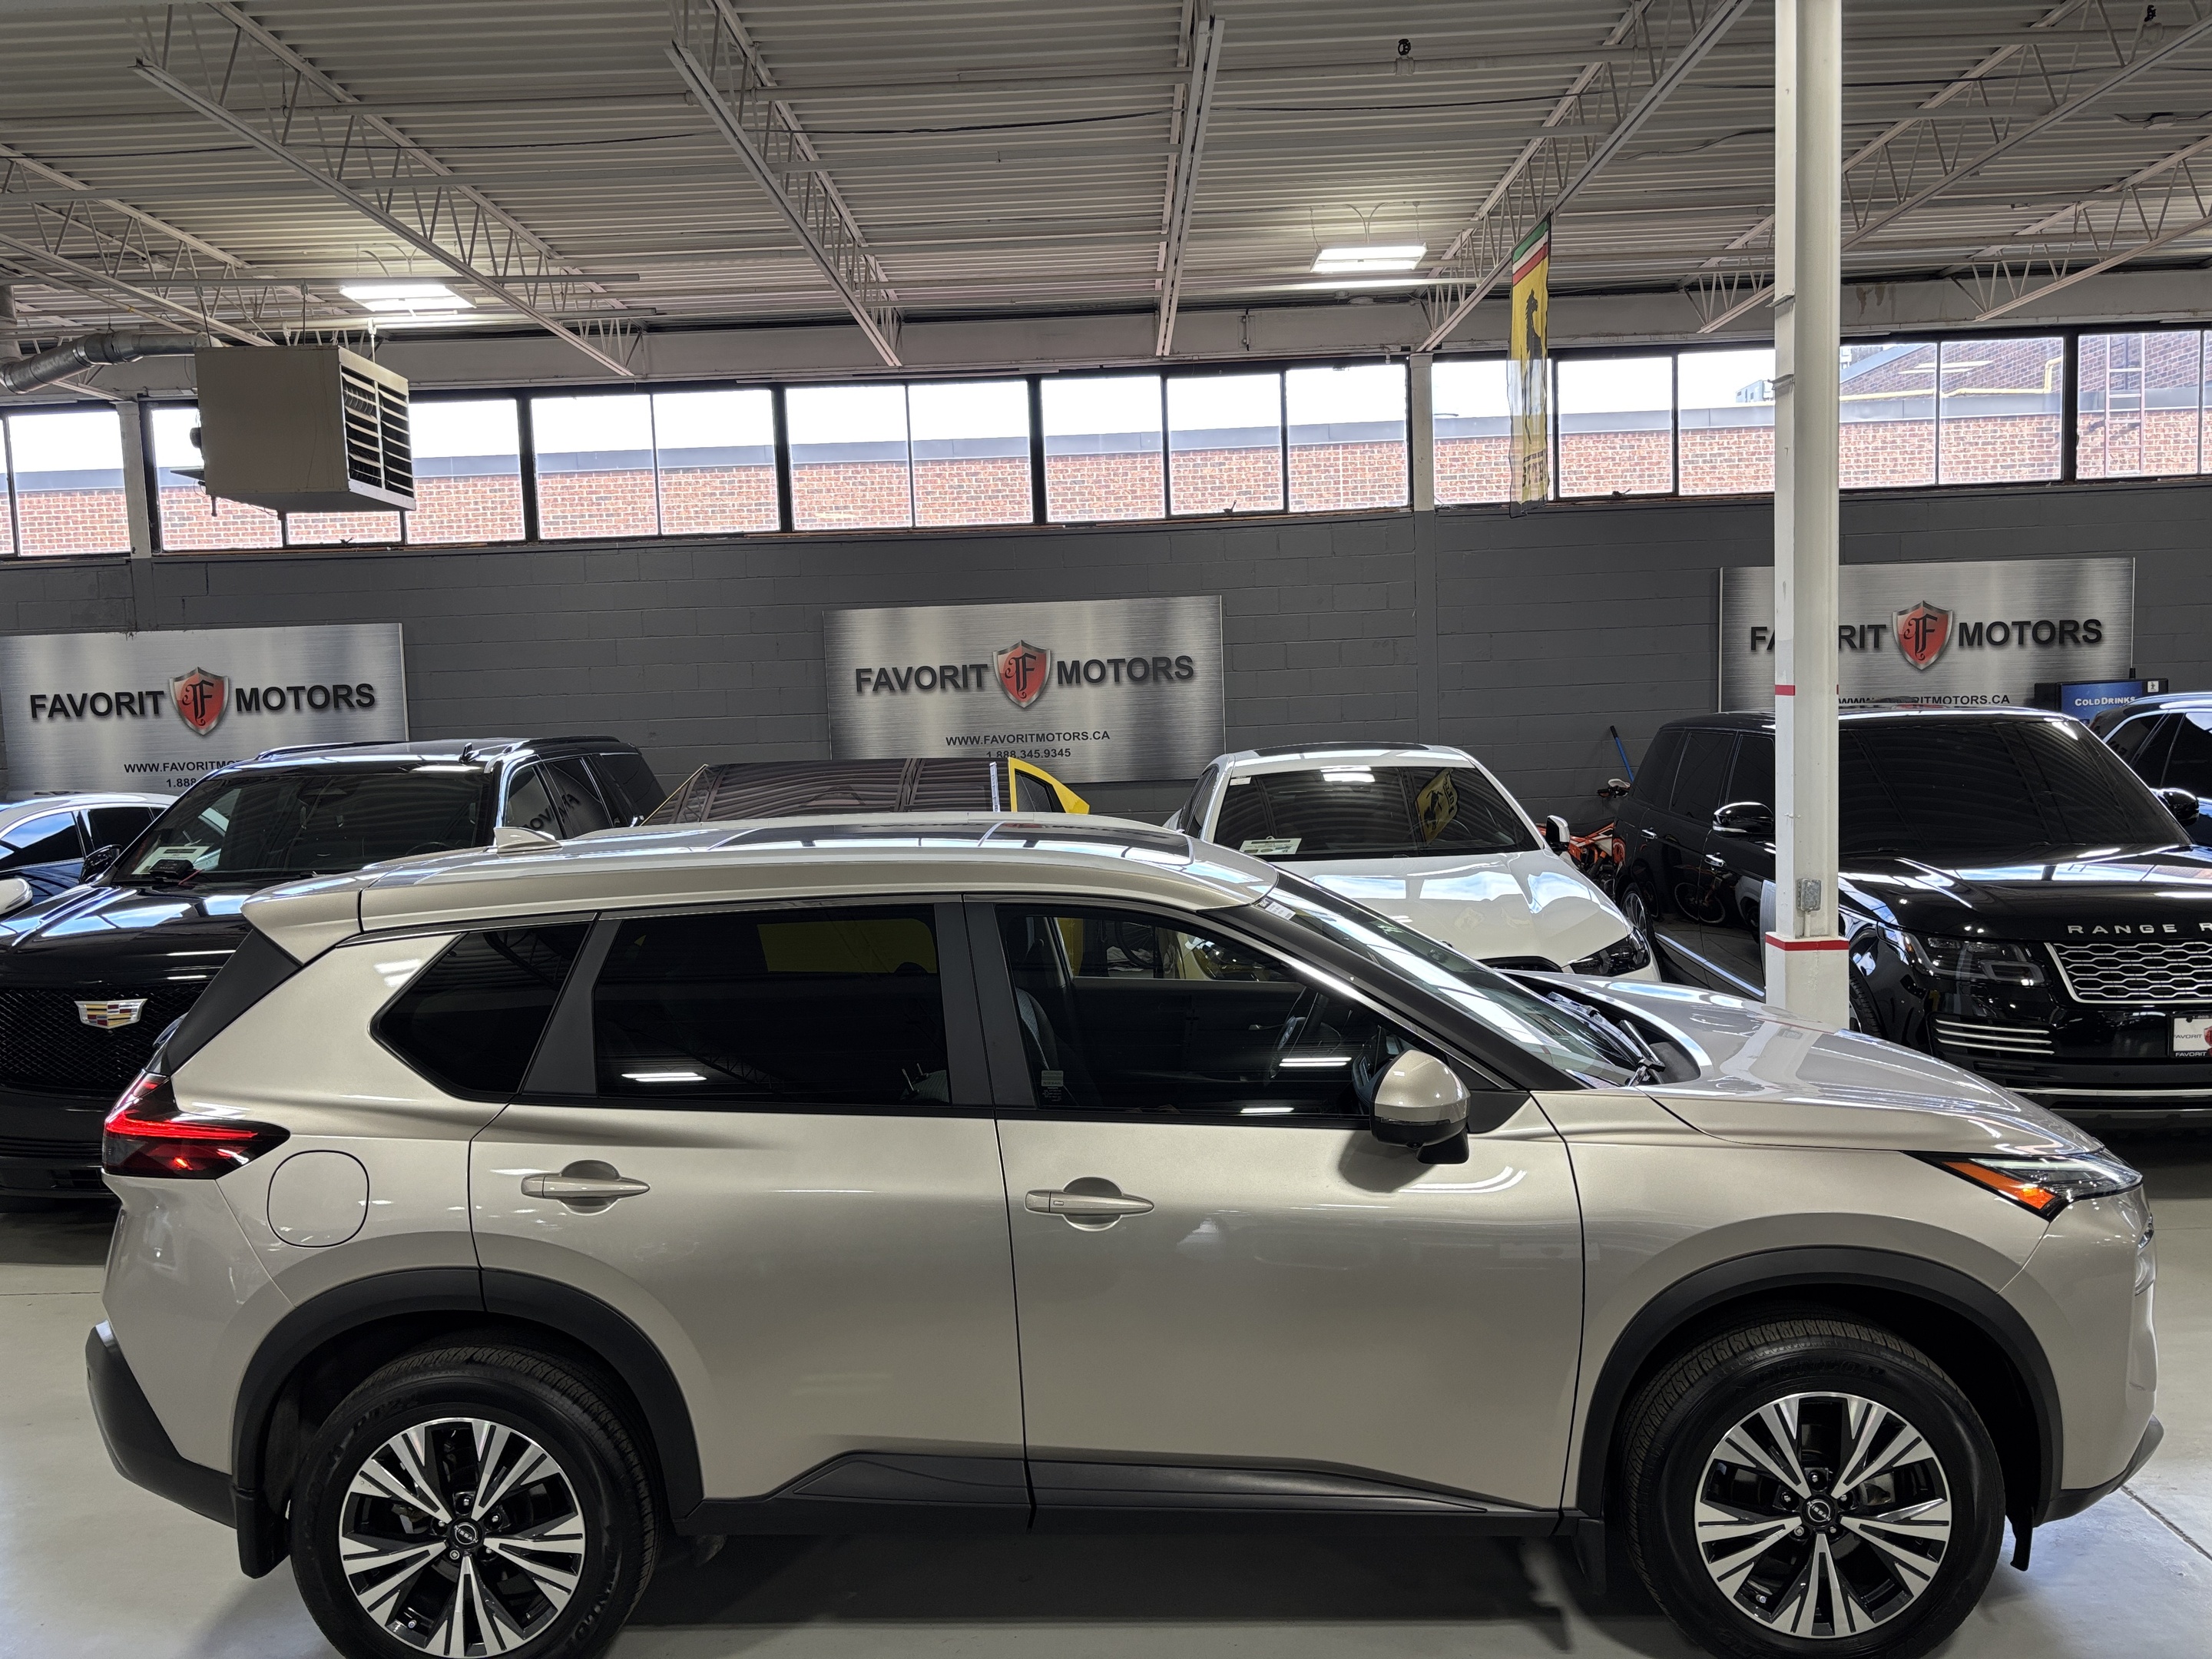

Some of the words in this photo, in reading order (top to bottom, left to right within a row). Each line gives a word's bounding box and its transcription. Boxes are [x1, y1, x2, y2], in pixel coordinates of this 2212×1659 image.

[1750, 624, 1887, 651] FRIT
[1959, 618, 2103, 648] MOTORS
[856, 664, 988, 693] FAVORIT
[1057, 655, 1194, 685] MOTORS
[30, 690, 164, 719] FAVORIT
[236, 683, 376, 713] MOTORS
[2075, 697, 2101, 707] COLD
[2101, 696, 2136, 705] DRINKS
[945, 730, 1111, 746] WWW.FAVORITMOTORS.CA
[986, 748, 1071, 760] 1888.345.9345
[2067, 924, 2177, 934] RANGE
